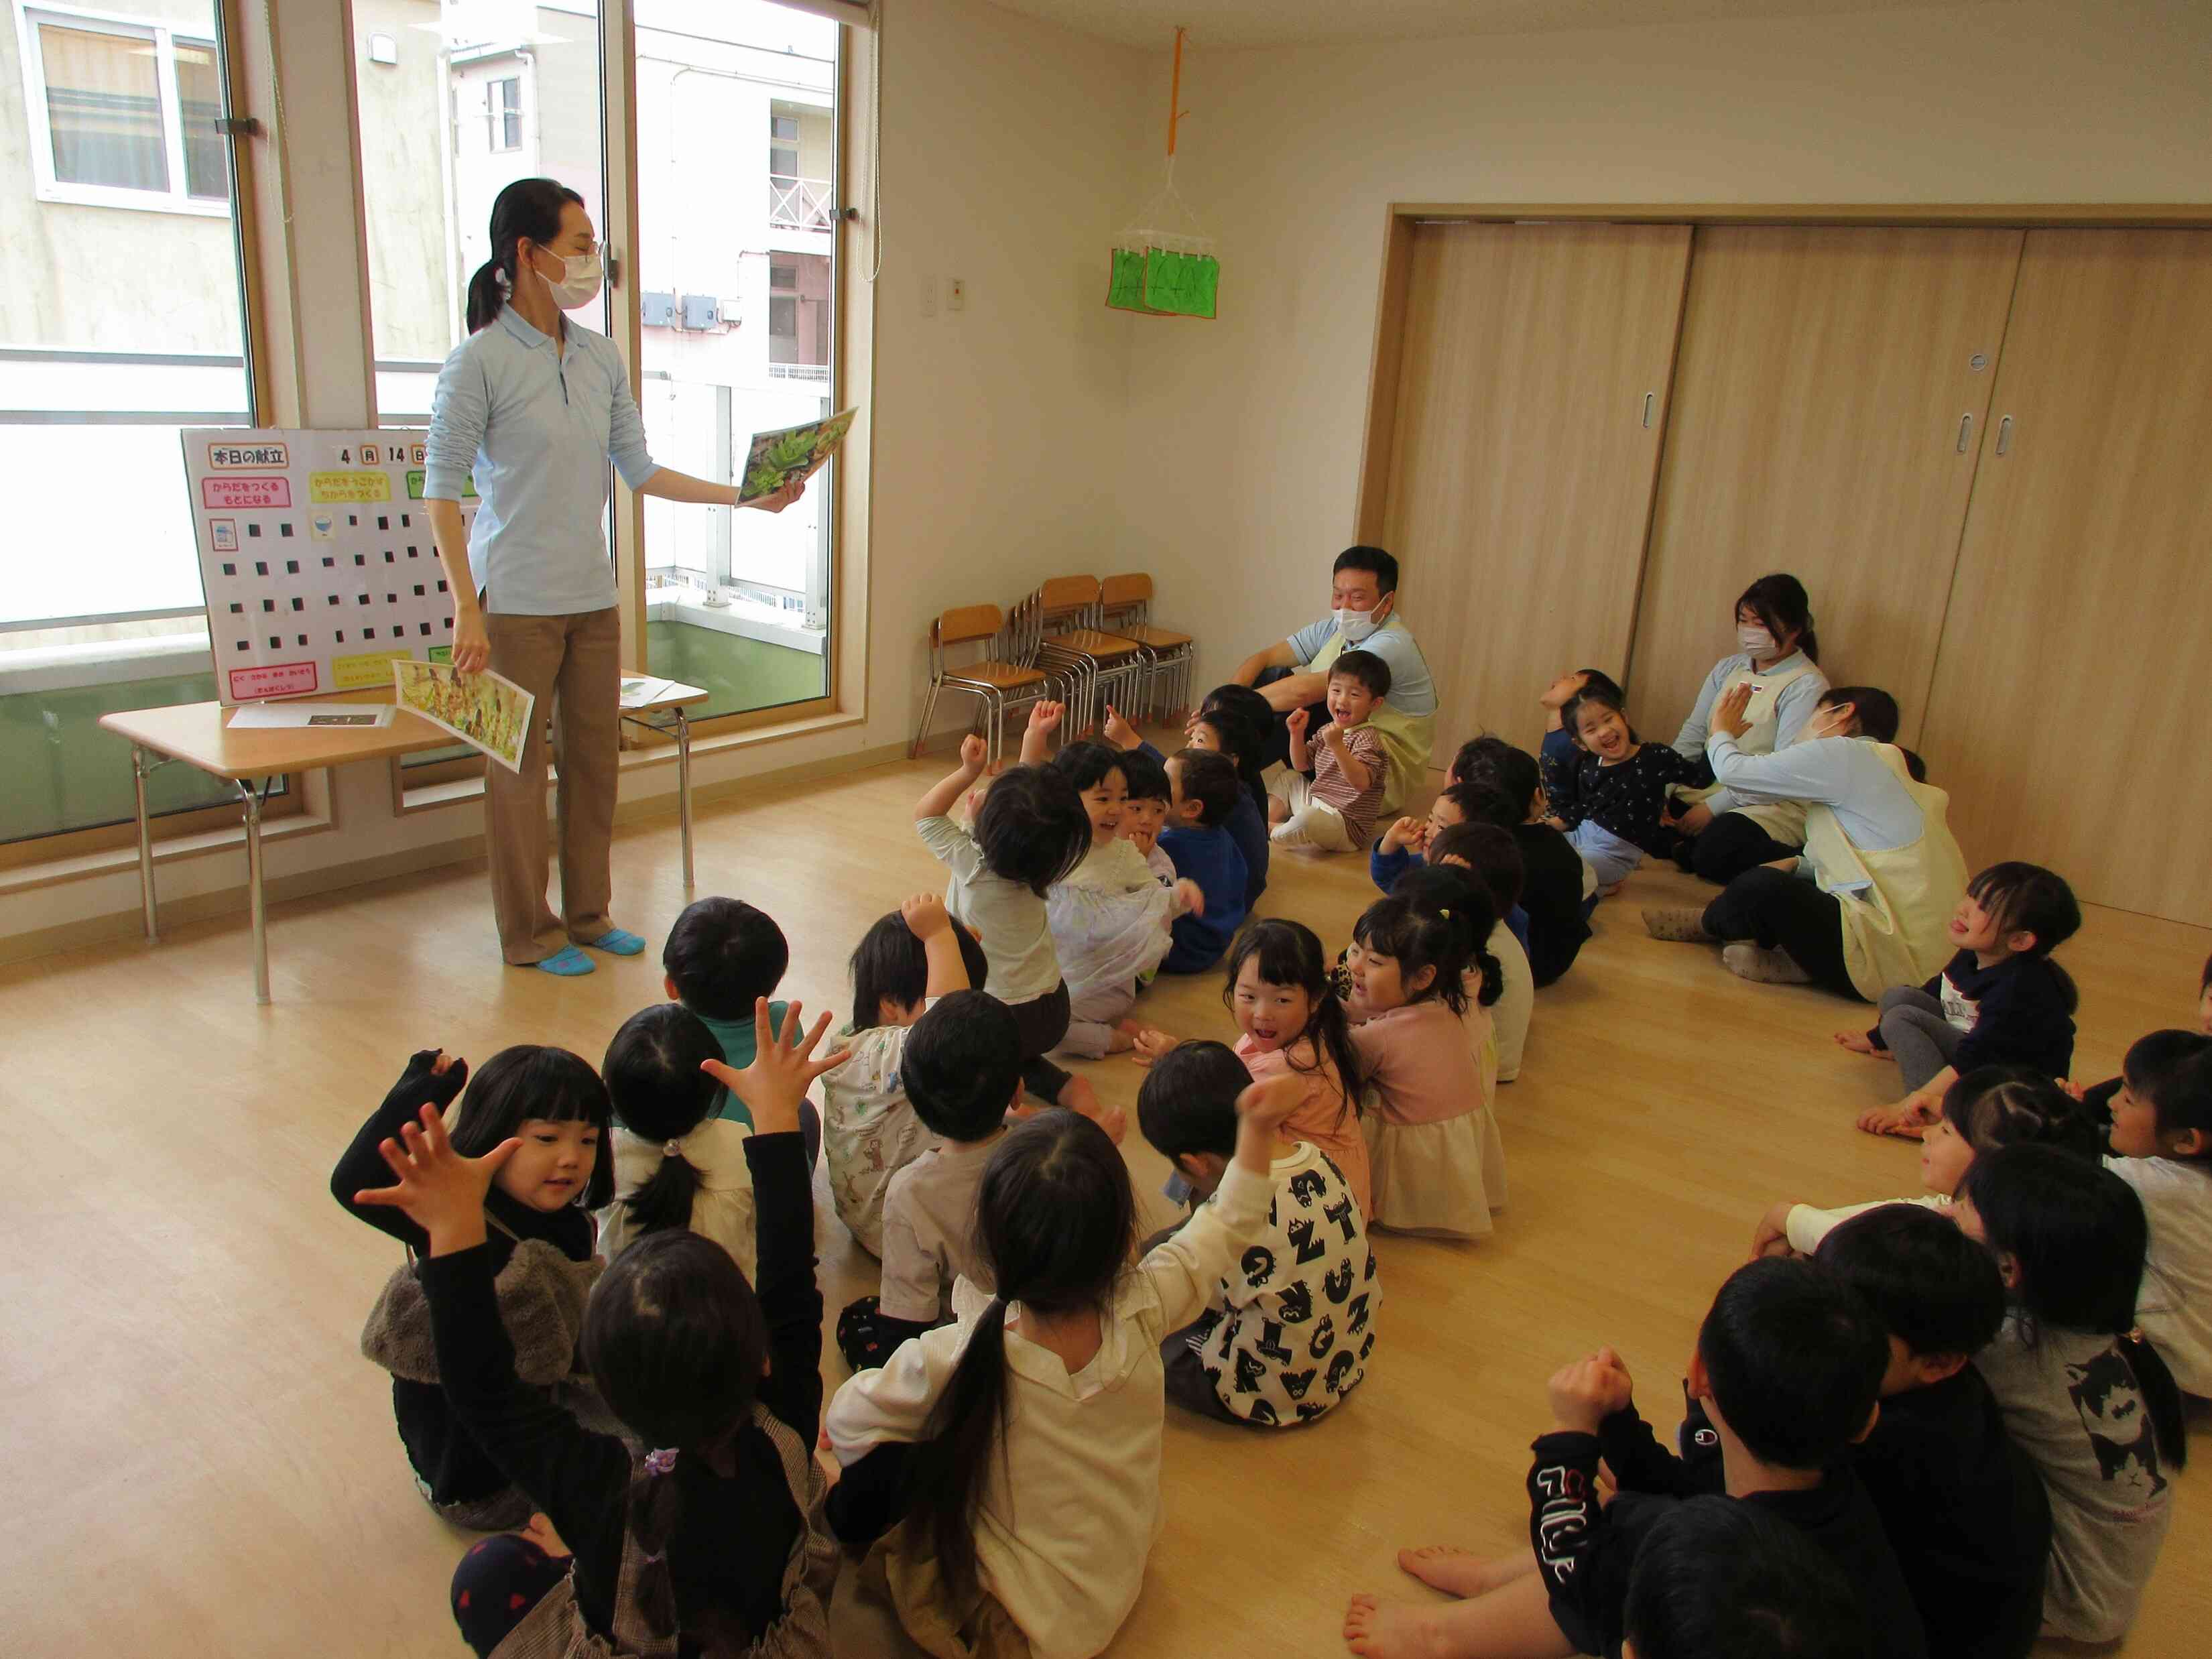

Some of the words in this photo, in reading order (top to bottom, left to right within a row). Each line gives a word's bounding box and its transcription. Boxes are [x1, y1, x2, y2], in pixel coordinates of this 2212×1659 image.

[213, 449, 284, 465] 本日の献立
[341, 449, 351, 464] 4
[365, 450, 374, 461] 月
[389, 447, 404, 462] 14
[213, 482, 279, 493] からだをつくる
[225, 495, 271, 505] もとになる
